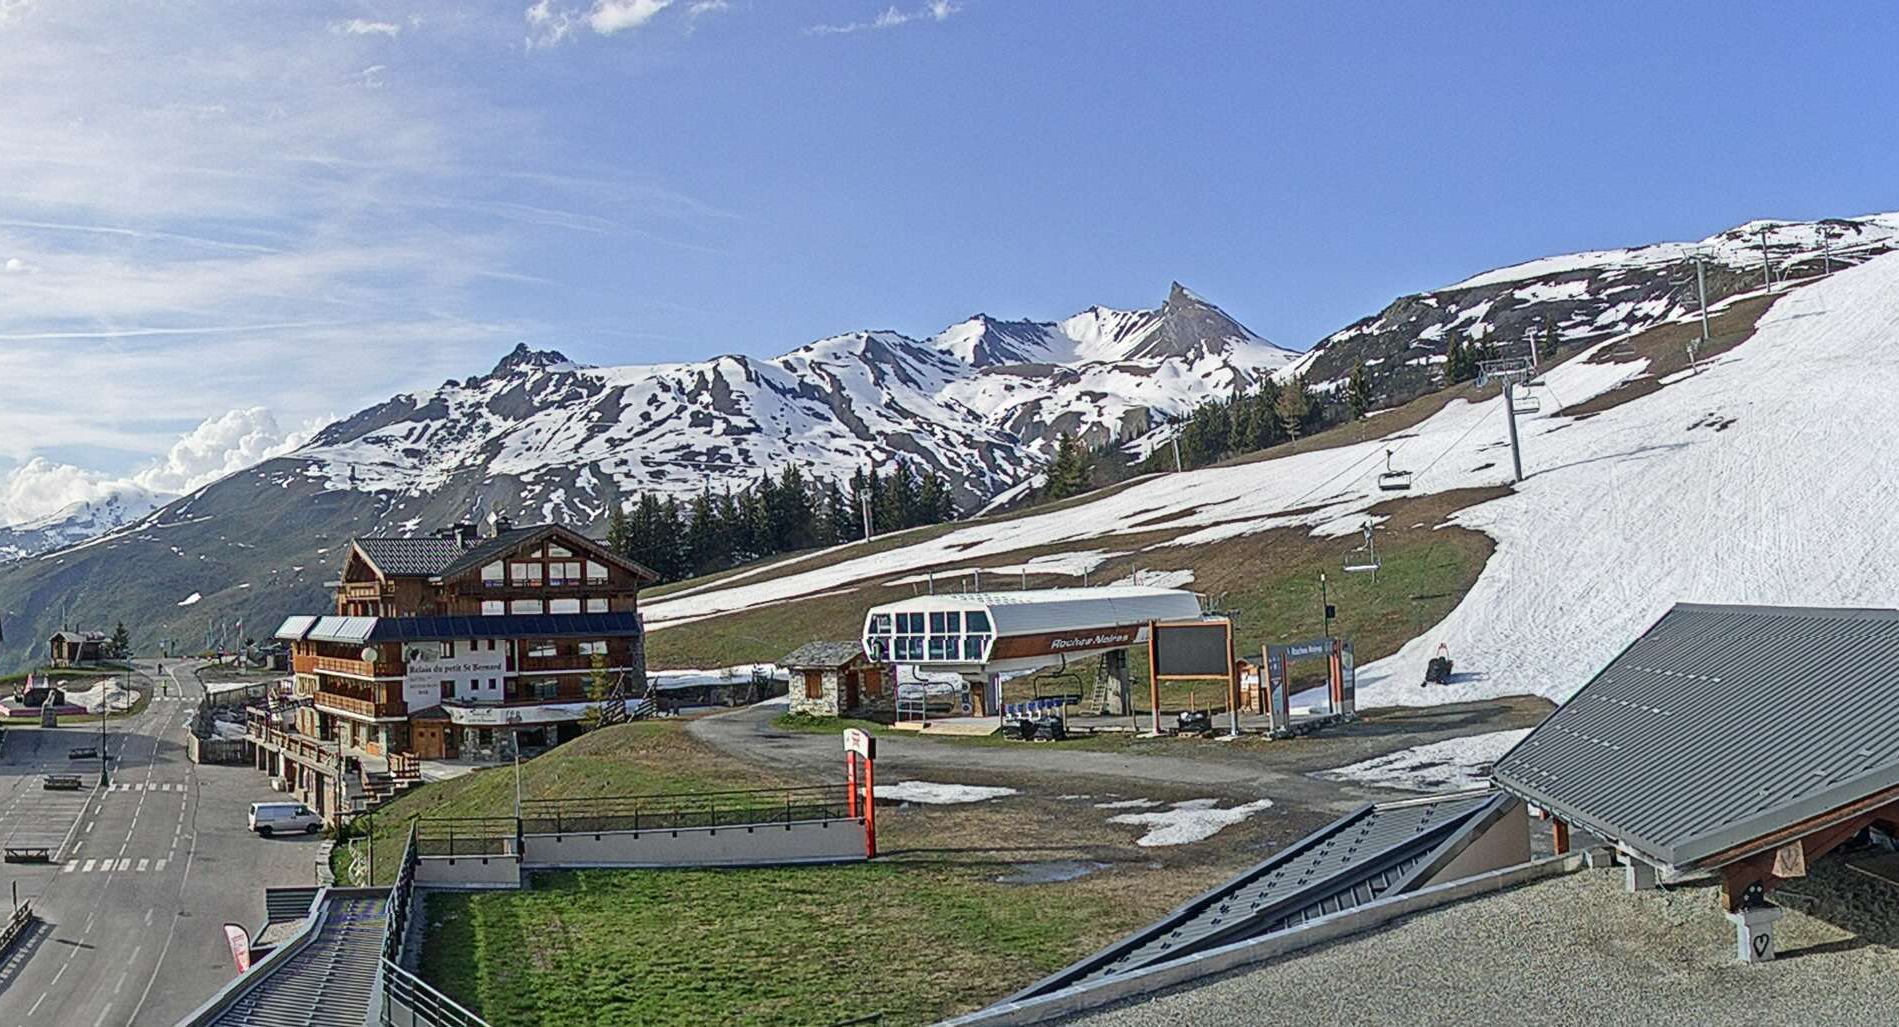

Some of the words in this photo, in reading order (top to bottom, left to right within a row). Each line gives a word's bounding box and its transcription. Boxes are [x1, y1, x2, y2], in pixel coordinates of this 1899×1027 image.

[445, 664, 461, 674] petit
[463, 663, 471, 672] St
[473, 662, 502, 672] Bernard
